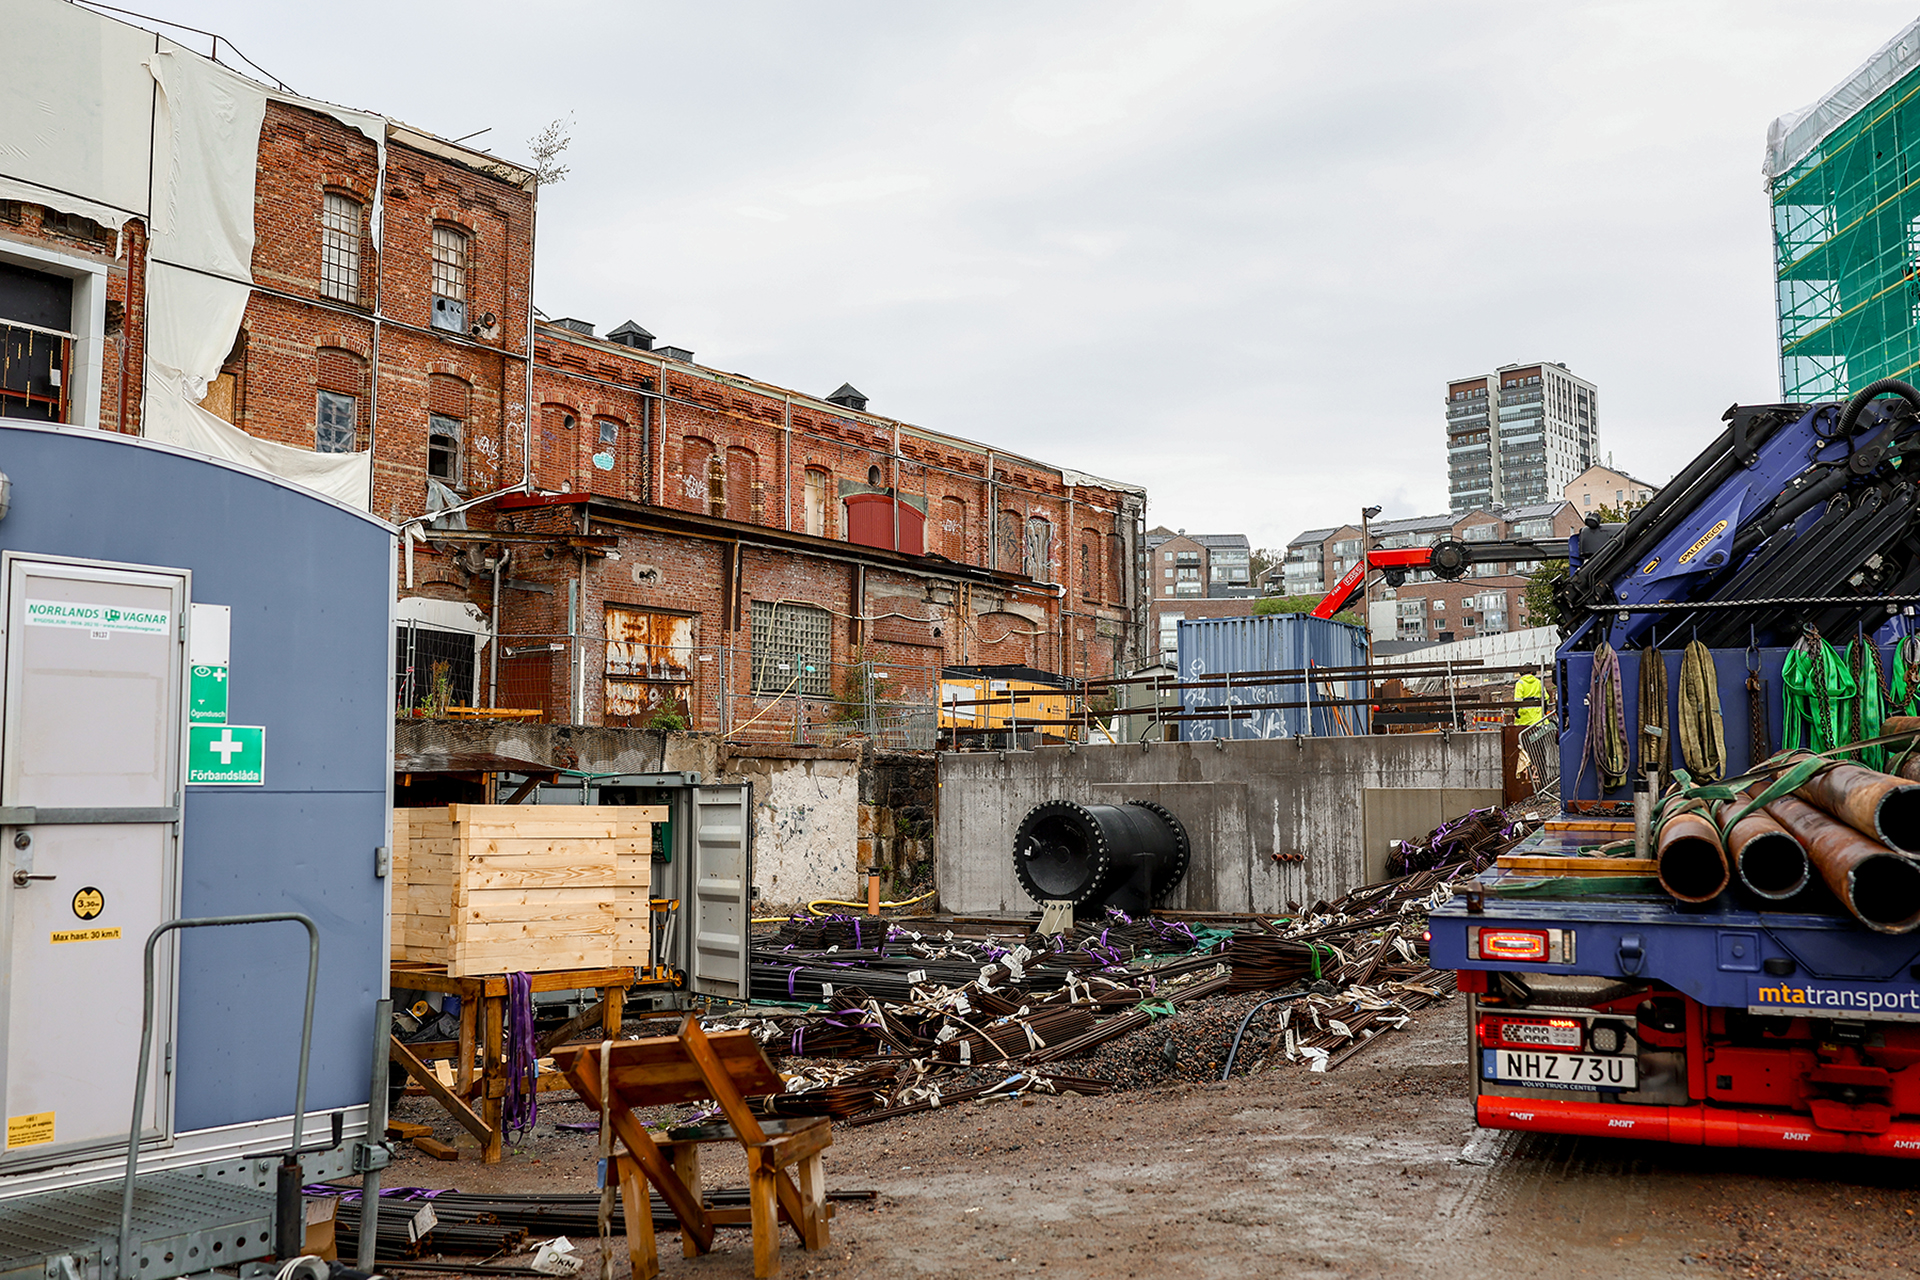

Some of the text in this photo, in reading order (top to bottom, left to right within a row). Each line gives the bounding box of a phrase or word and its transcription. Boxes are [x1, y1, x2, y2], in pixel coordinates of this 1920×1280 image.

[1681, 522, 1725, 563] PALFINGER
[28, 604, 167, 624] NORRLANDS VAGNAR
[190, 708, 226, 719] Ögondusch
[190, 769, 259, 781] Förbandslåda
[53, 929, 119, 942] Max hast. 30 km/t
[1507, 1053, 1623, 1083] NHZ 73U
[1521, 1080, 1597, 1092] VOLVO TRUCK CENTER
